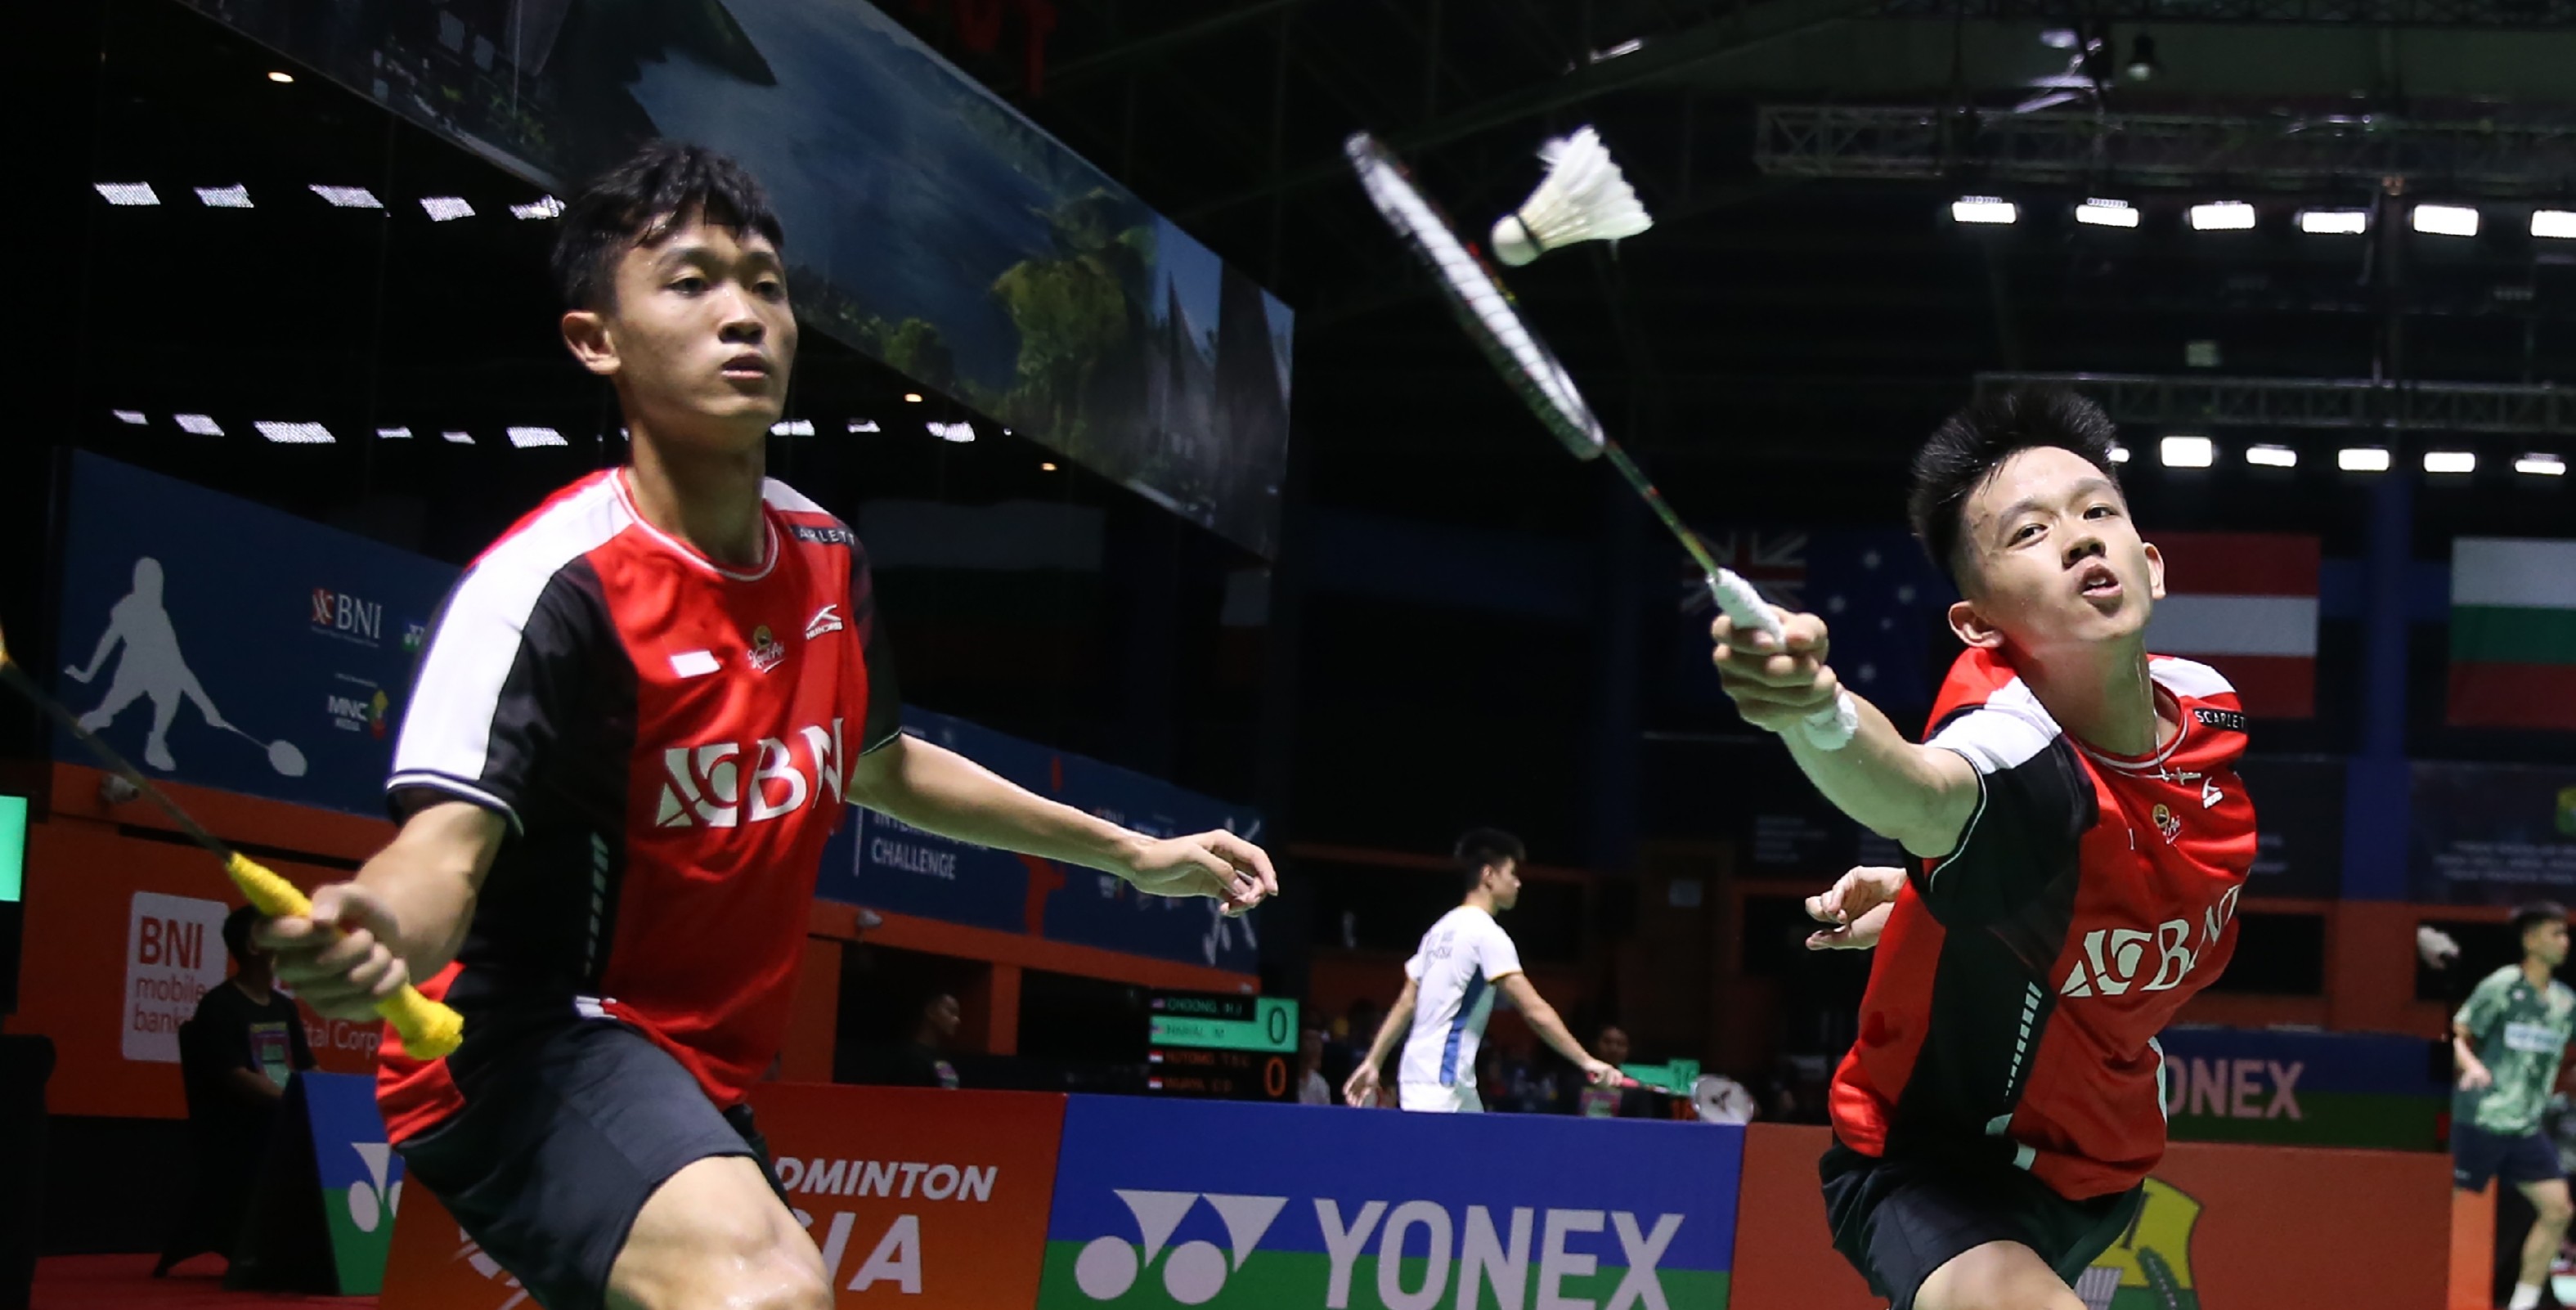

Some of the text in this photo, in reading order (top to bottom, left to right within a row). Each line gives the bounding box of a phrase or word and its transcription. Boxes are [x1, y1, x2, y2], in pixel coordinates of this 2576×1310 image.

[336, 594, 382, 639] BNI
[2195, 710, 2246, 729] SCARLET
[870, 837, 957, 881] CHALLENGE
[140, 915, 204, 970] BNI
[136, 972, 206, 1003] mobile
[1269, 1007, 1287, 1043] 0
[1265, 1057, 1286, 1097] 0
[2166, 1055, 2305, 1121] ONEX
[775, 1156, 998, 1202] DMINTON
[791, 1208, 922, 1294] IA
[1313, 1197, 1686, 1310] YONEX
